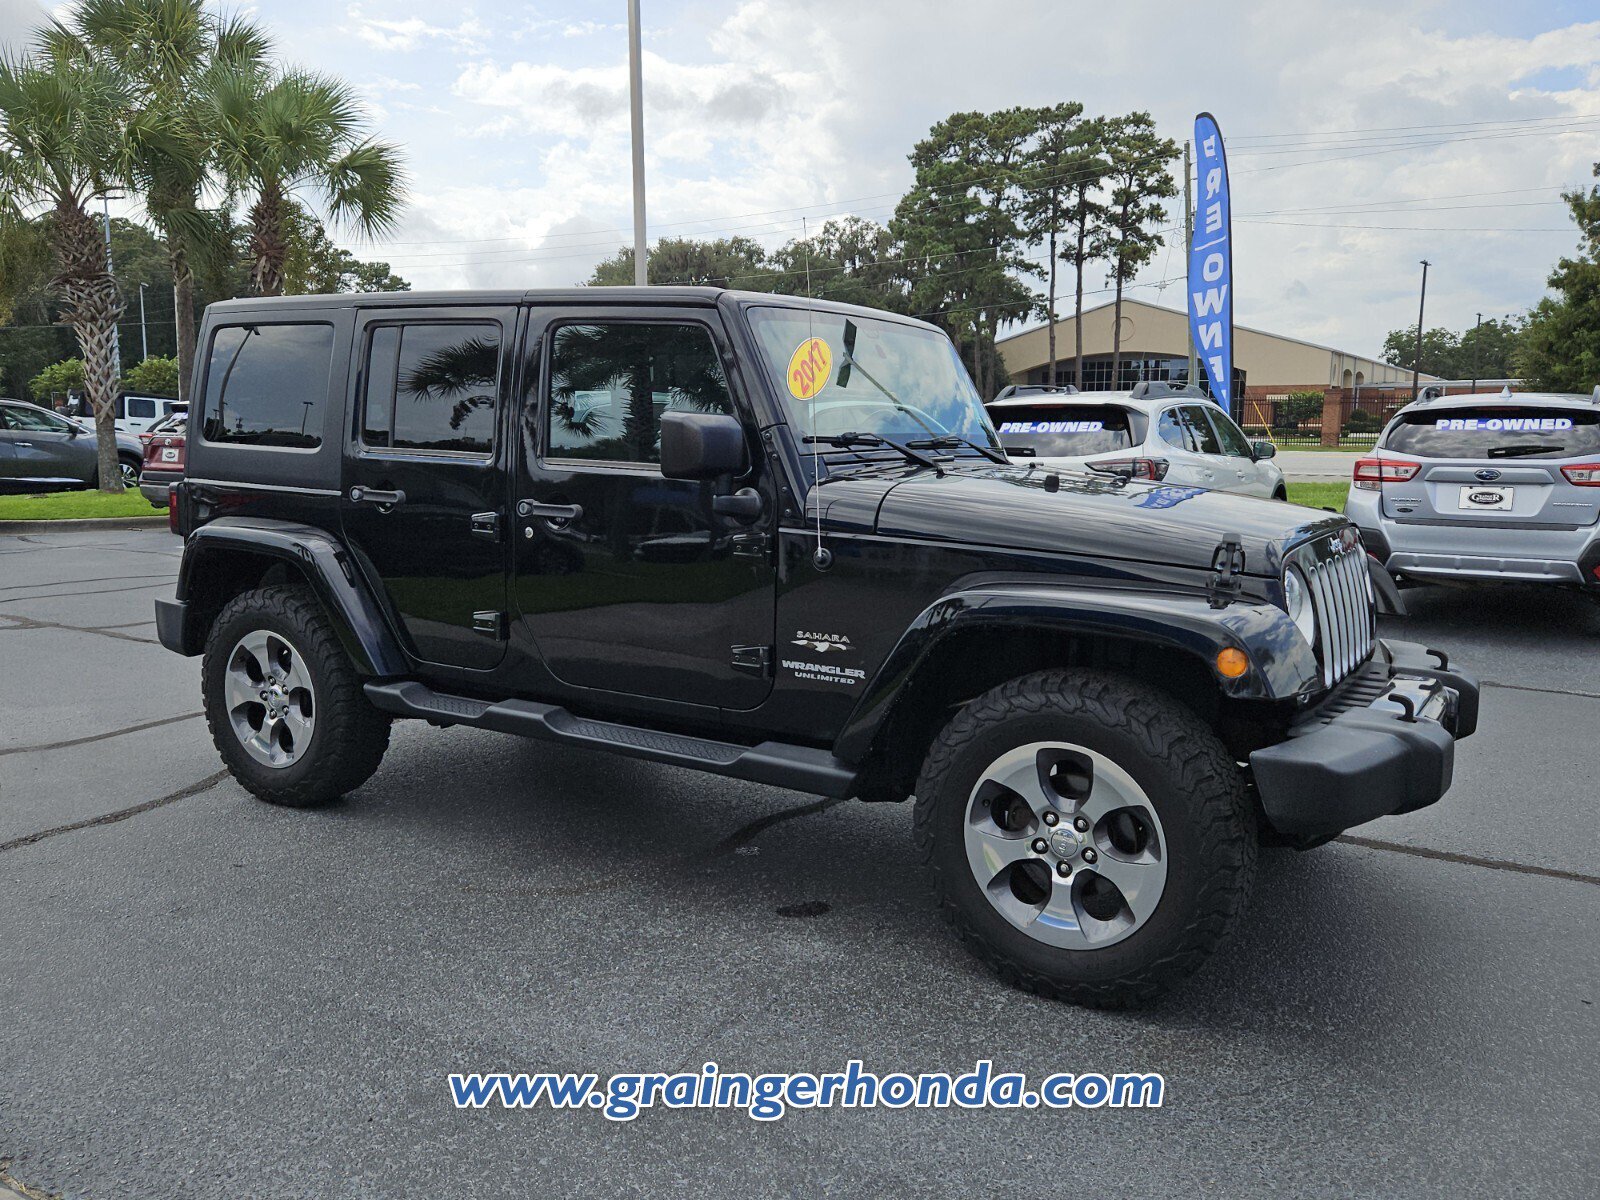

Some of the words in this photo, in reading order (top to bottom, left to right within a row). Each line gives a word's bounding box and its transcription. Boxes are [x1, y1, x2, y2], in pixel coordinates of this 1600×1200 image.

[793, 341, 827, 396] 2017
[999, 421, 1103, 433] PRE-OWNED
[1435, 418, 1572, 430] PRE-OWNED
[797, 631, 850, 643] SAHARA
[782, 660, 865, 679] WRANGLER
[795, 672, 855, 684] UNLIMITED
